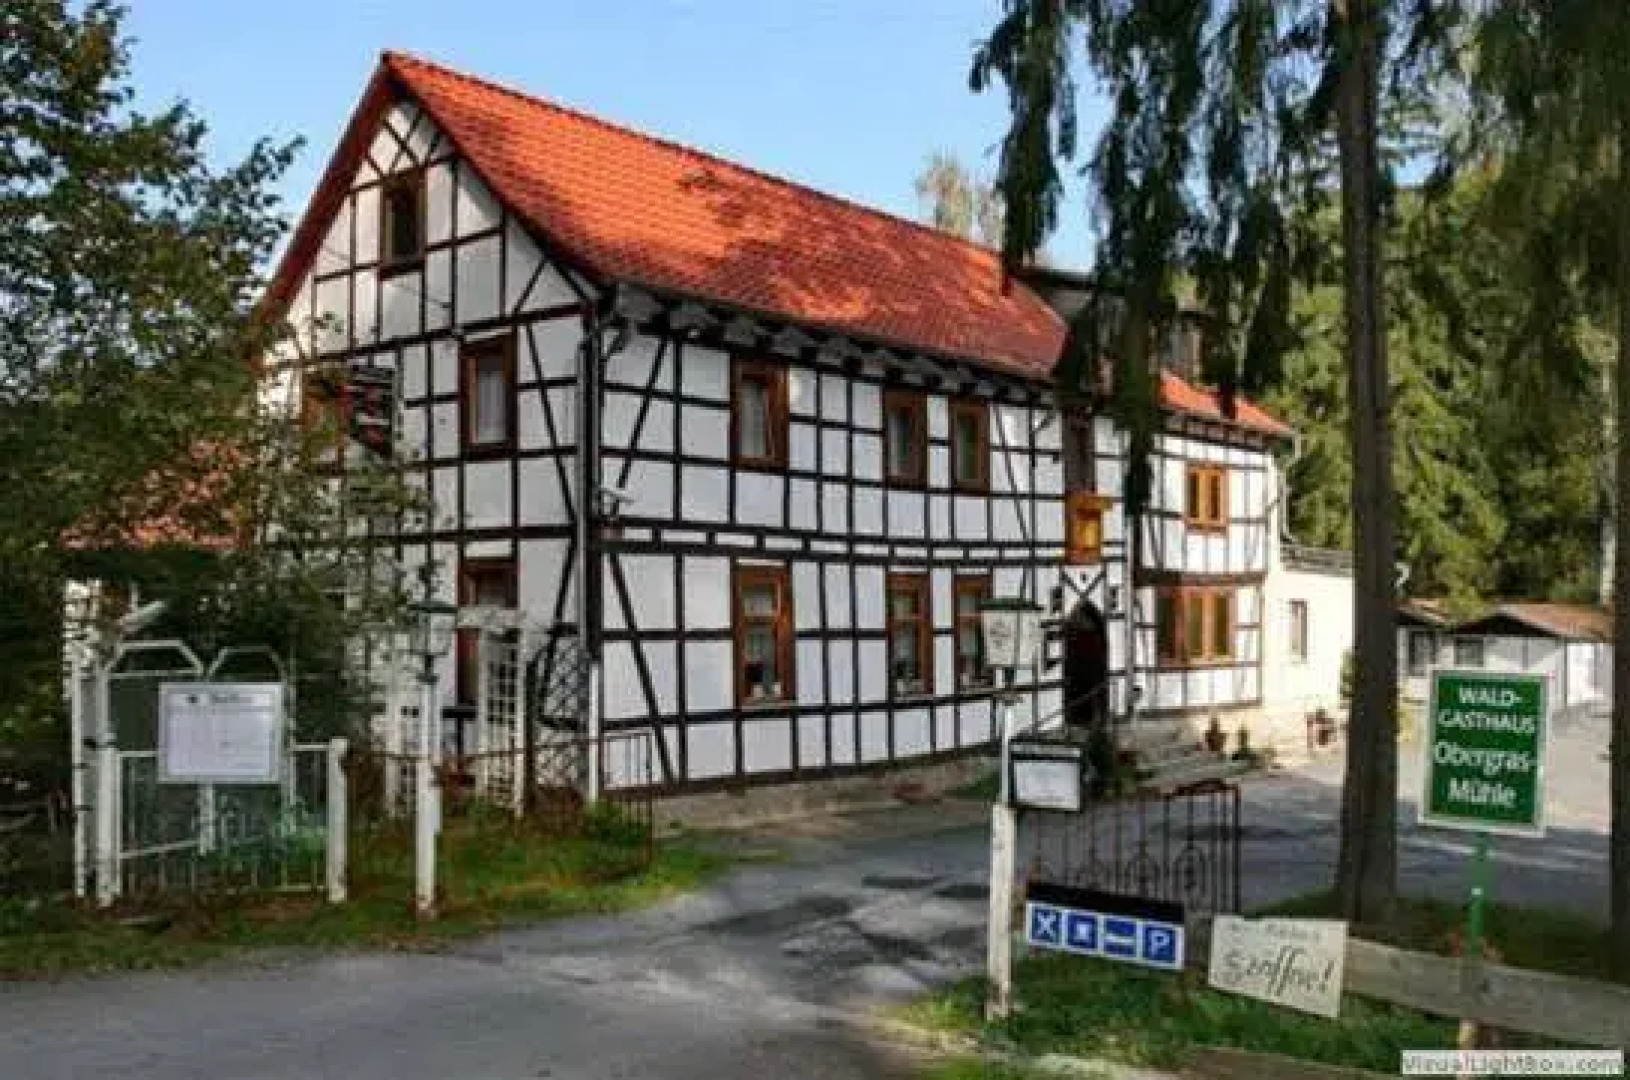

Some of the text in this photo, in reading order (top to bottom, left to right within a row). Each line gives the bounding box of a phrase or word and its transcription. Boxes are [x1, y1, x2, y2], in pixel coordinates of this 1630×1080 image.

[1458, 687, 1523, 707] WALD-
[1447, 777, 1518, 809] Mühle
[1149, 931, 1172, 956] P
